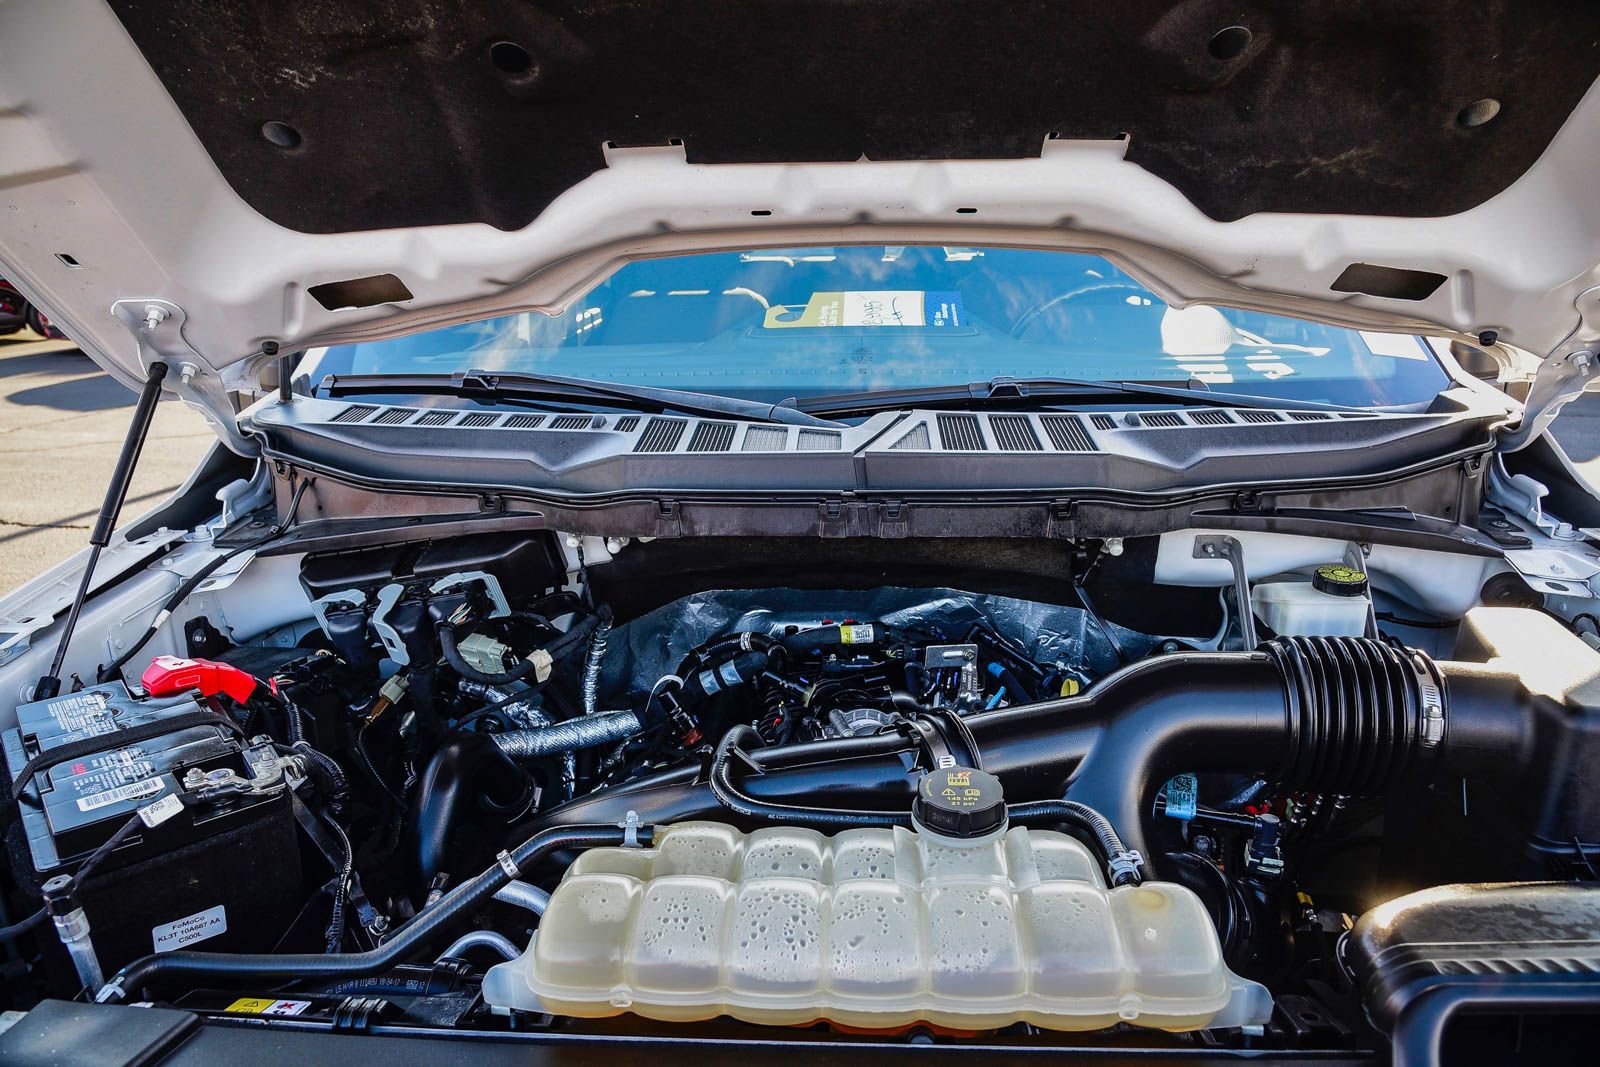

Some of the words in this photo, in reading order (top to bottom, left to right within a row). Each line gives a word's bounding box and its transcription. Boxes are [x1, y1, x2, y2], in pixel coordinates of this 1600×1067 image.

[157, 932, 179, 943] KL3T
[209, 917, 221, 926] AA
[172, 916, 205, 930] FoMoCo
